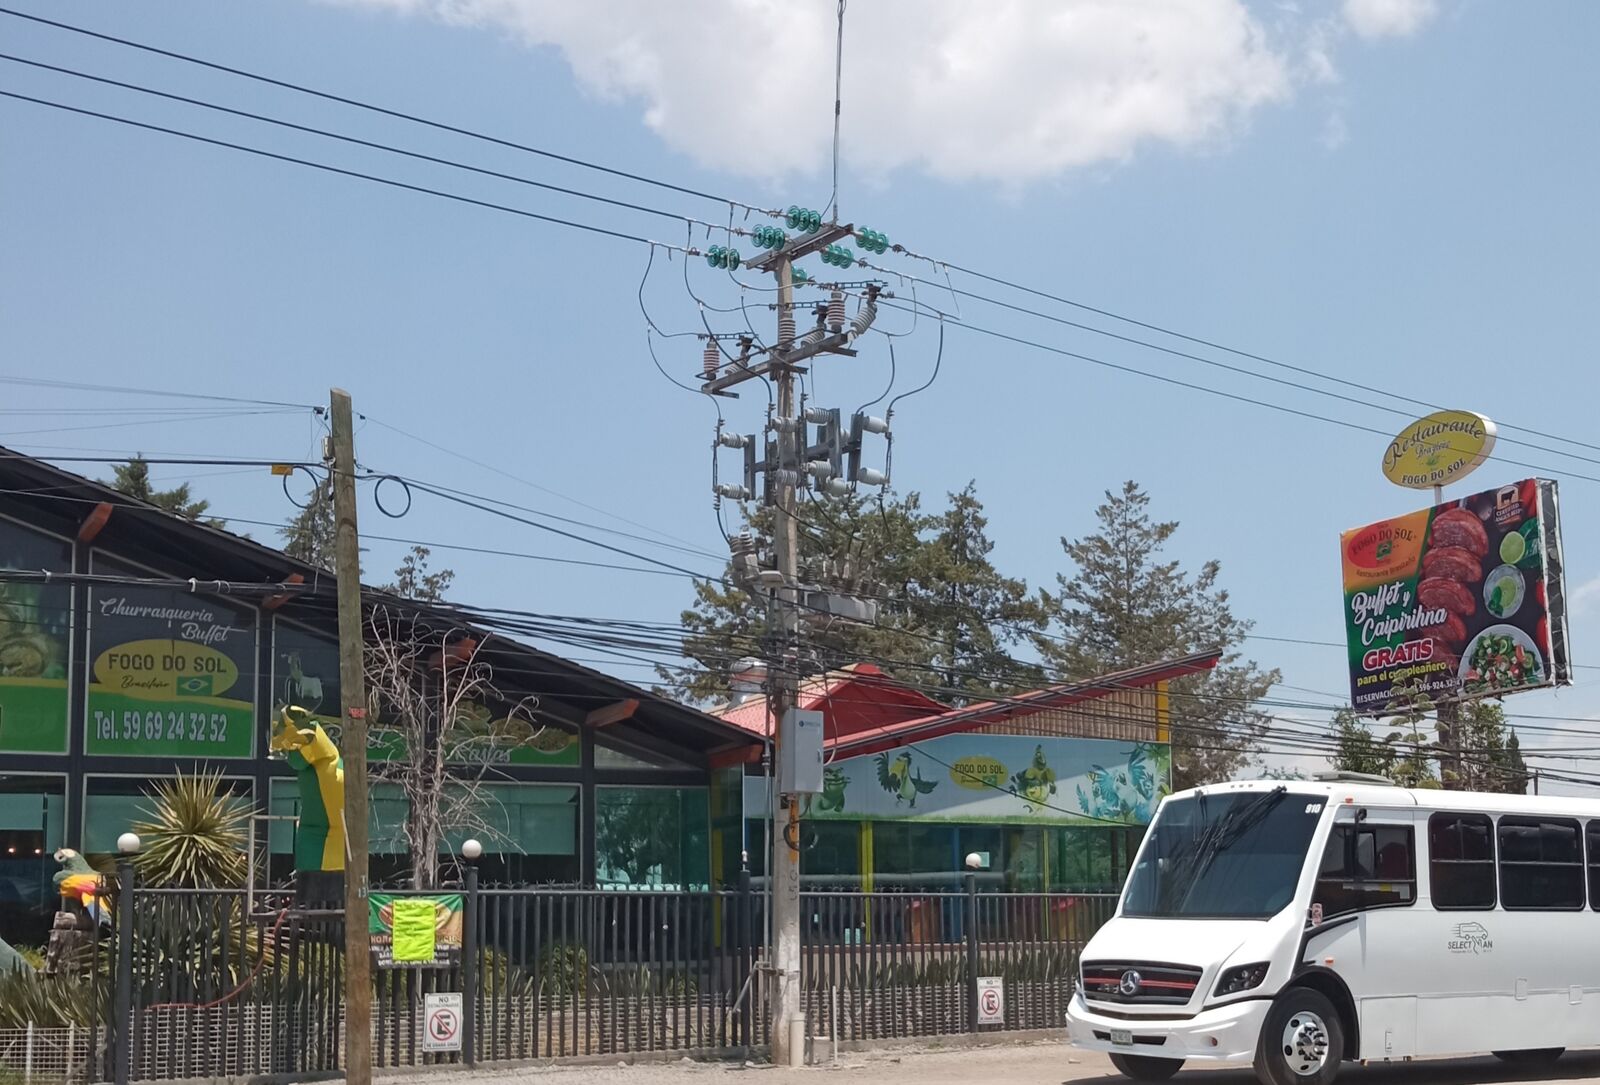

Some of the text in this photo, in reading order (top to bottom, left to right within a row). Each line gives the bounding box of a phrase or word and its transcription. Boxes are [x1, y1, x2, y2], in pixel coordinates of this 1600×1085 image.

[1385, 419, 1482, 472] Restaurante
[1402, 458, 1466, 484] FOGO DO SOL
[1379, 528, 1393, 541] DO
[1394, 528, 1413, 541] SOL
[1351, 581, 1411, 624] Buffet y
[181, 622, 248, 645] Buffet
[1361, 605, 1447, 646] Caipirihna
[109, 654, 227, 673] FOGO DO SOL
[1363, 638, 1433, 671] GRATIS
[1357, 662, 1447, 687] para el cpleañero
[95, 710, 227, 741] Tel. 59 69 24 32 52
[990, 765, 1004, 774] SOL
[1305, 803, 1321, 814] 910
[1448, 940, 1472, 949] SELECT
